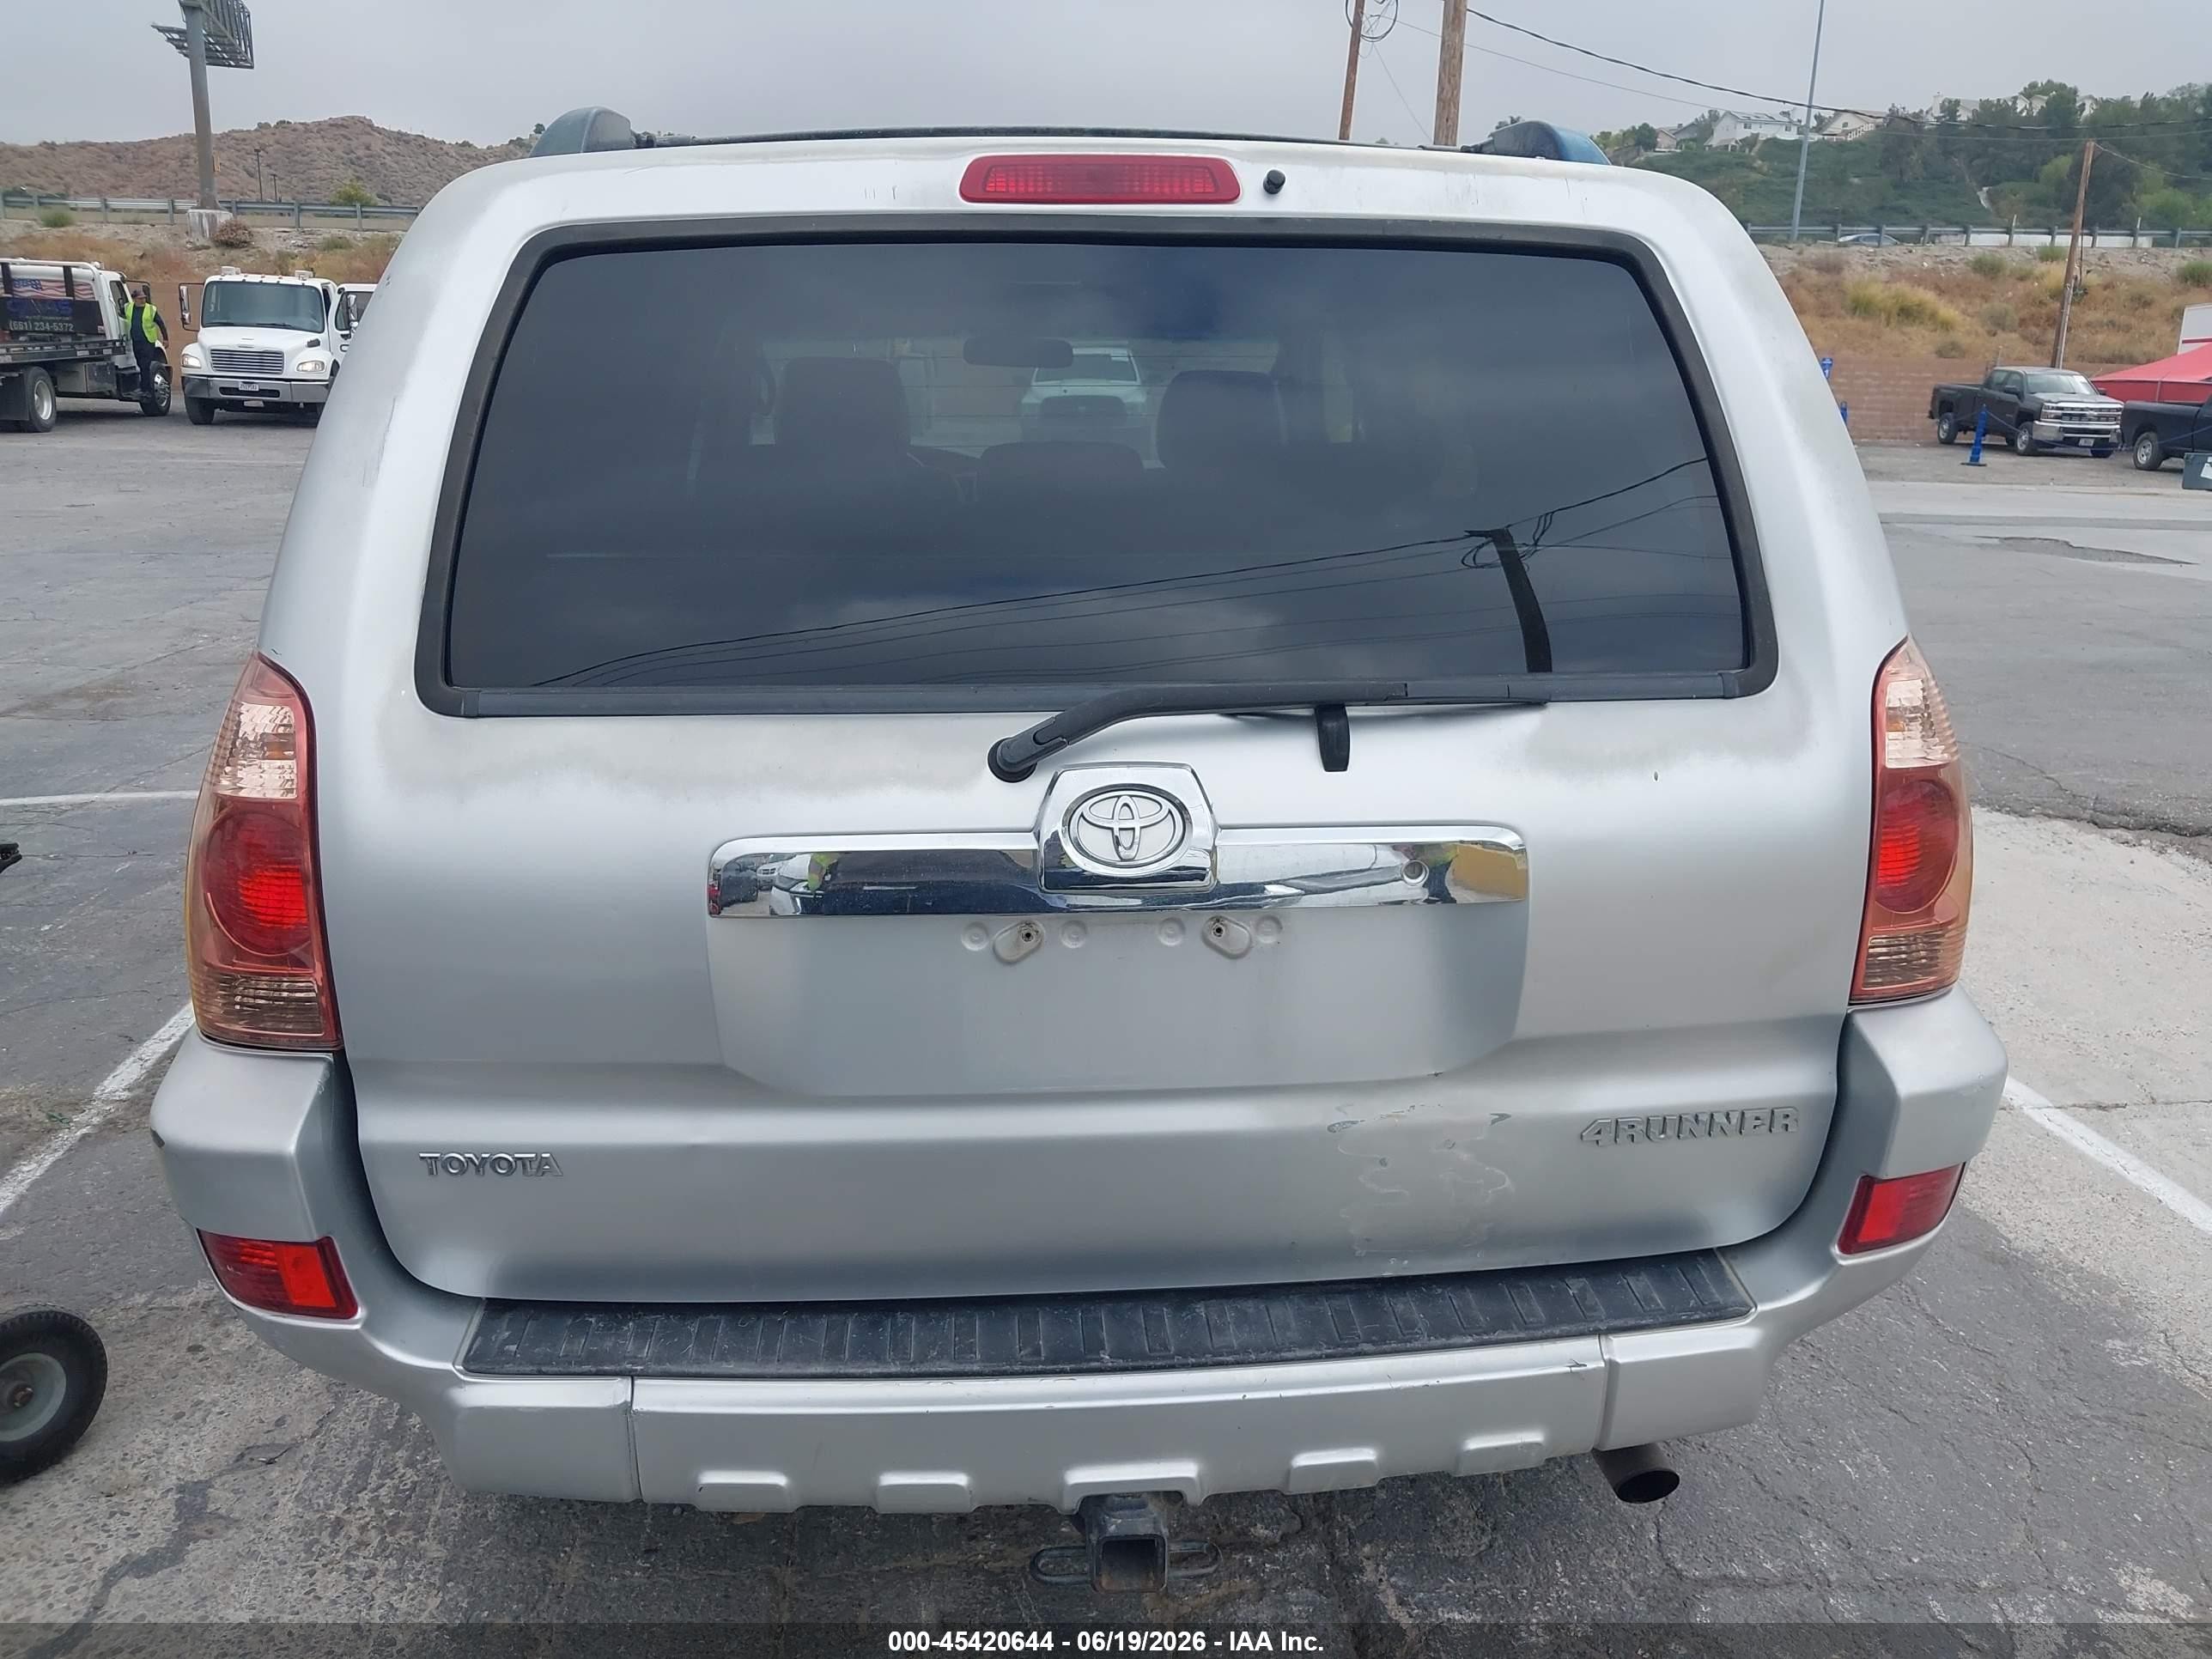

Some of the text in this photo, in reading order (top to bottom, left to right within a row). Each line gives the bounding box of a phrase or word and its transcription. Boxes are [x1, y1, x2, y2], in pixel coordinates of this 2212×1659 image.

[33, 321, 75, 332] 234-5372
[1579, 1106, 1801, 1147] 4RUNNER
[418, 1152, 564, 1177] TOYOTA
